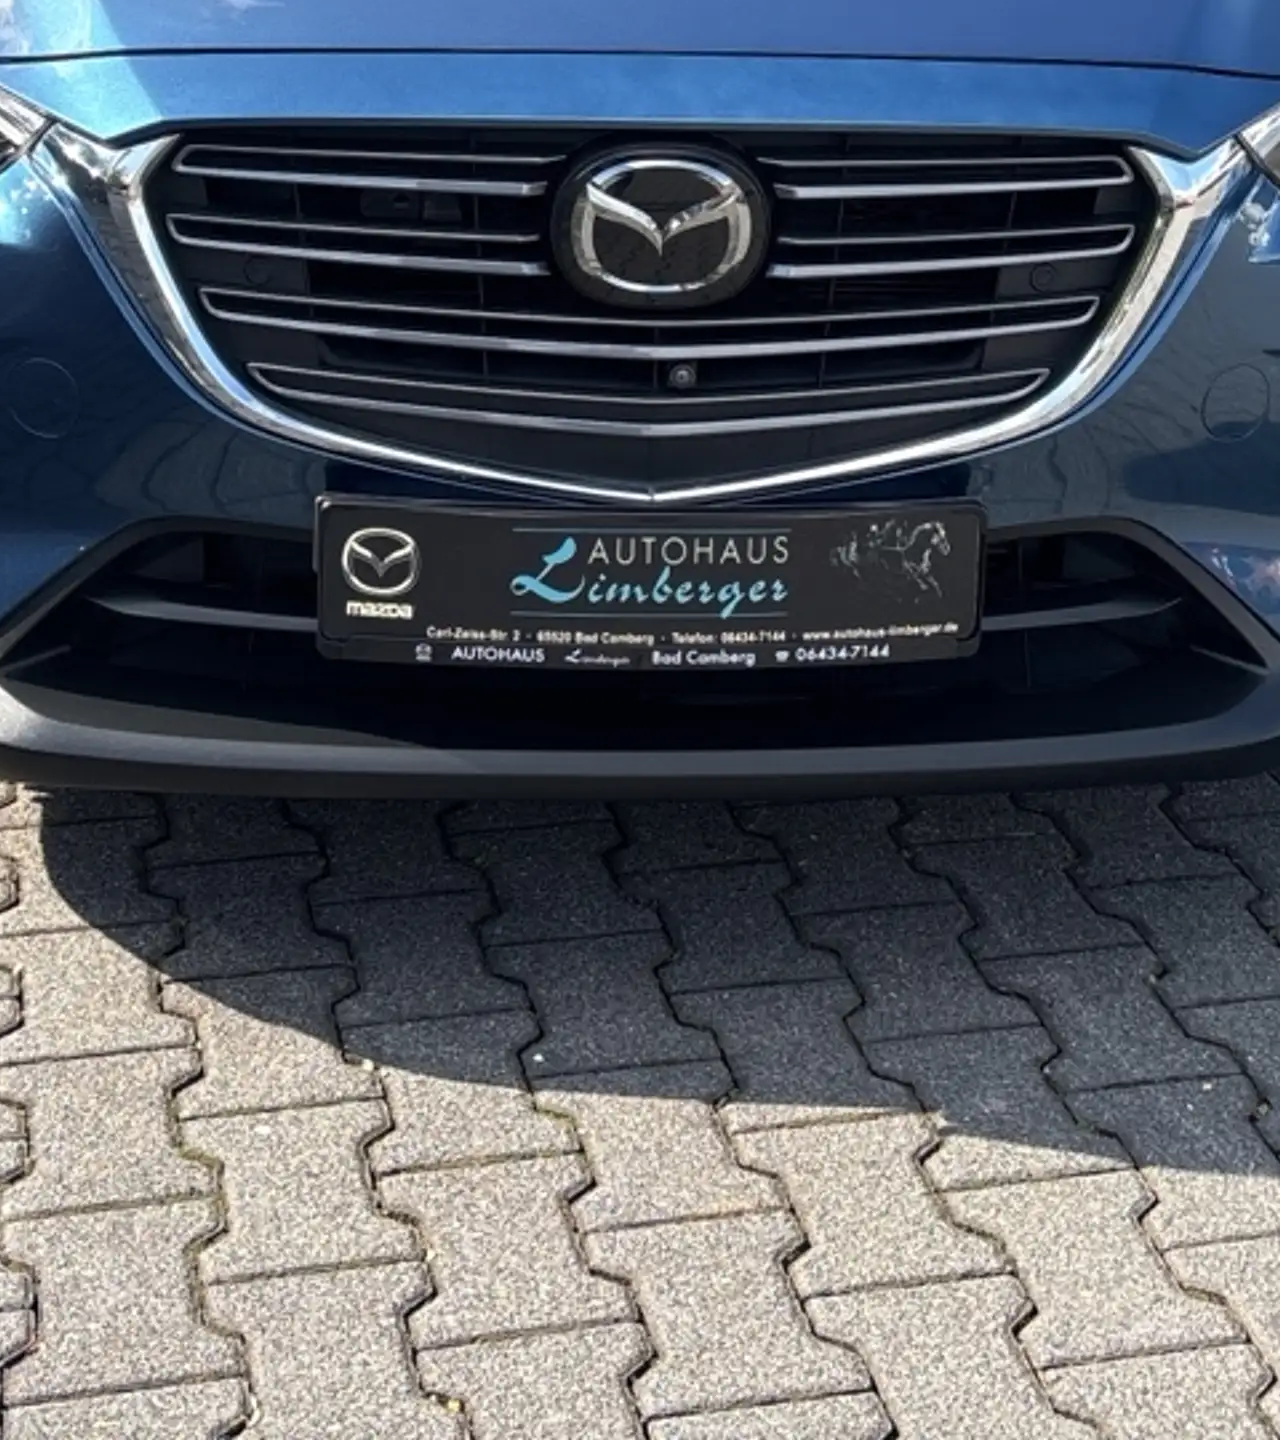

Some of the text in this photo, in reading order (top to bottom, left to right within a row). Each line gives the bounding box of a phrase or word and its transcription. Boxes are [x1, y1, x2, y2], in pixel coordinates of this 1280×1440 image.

[586, 536, 790, 565] AUTOHAUS
[509, 536, 789, 620] Limberger
[346, 599, 414, 620] mazda
[451, 645, 546, 663] AUTOHAUS
[651, 649, 683, 666] Bad
[685, 646, 757, 667] Camberg
[794, 643, 891, 662] 06434-7144
